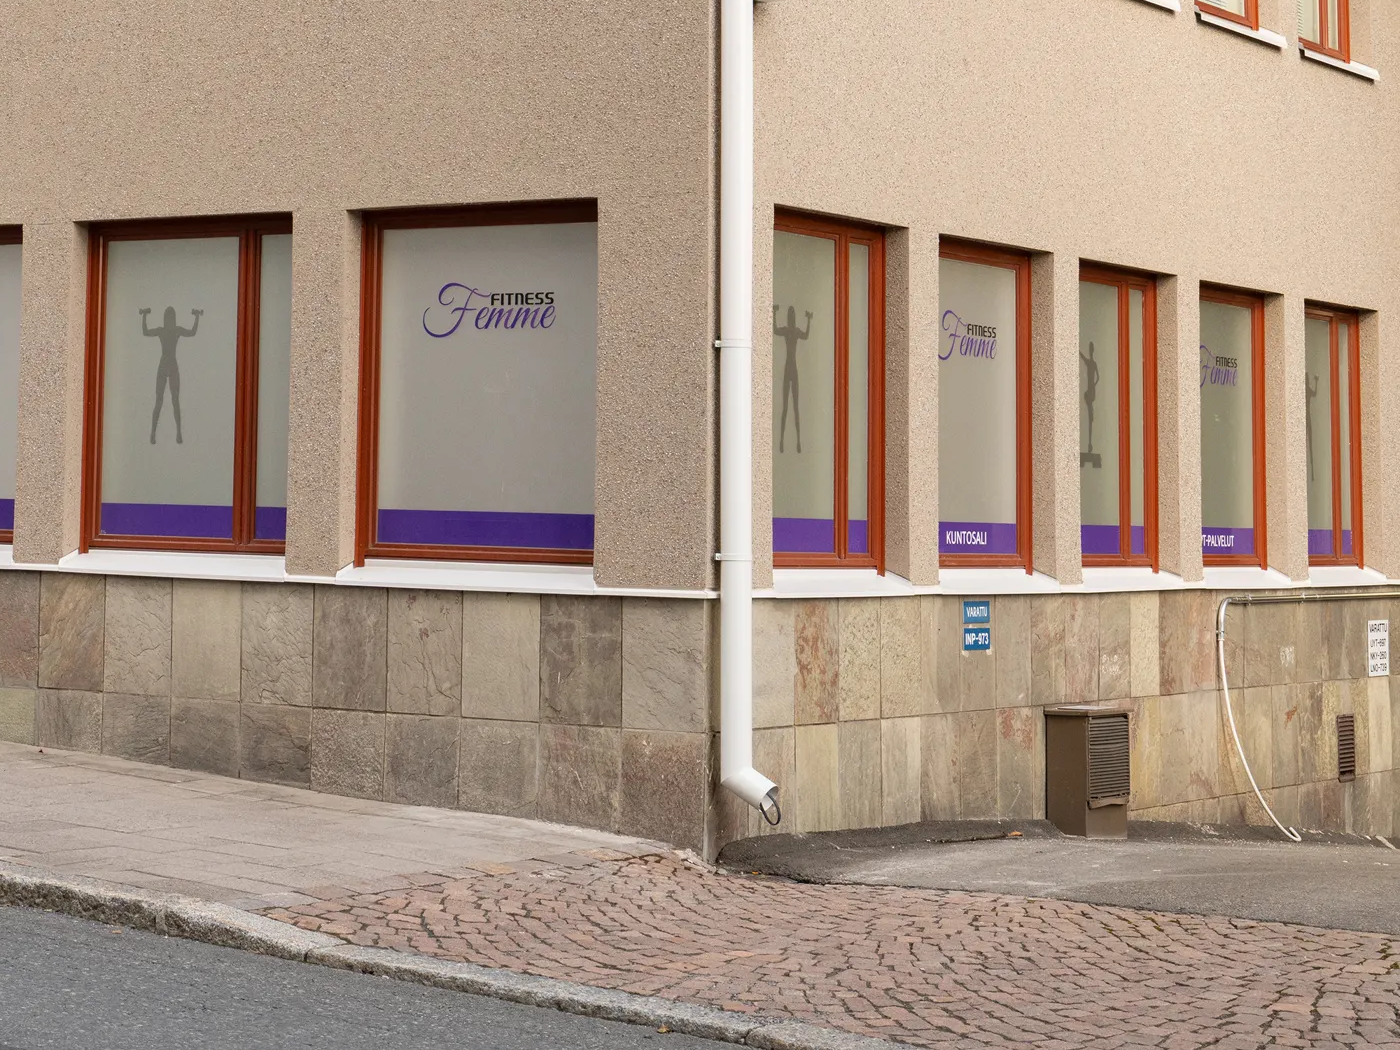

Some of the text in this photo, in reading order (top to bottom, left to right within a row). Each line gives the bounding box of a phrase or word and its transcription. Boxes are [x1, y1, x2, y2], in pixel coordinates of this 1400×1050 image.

[490, 292, 555, 306] FITNESS
[422, 282, 557, 338] Femme
[938, 309, 998, 360] Femme
[966, 323, 997, 339] FITNESS
[1215, 355, 1238, 369] FITNESS
[946, 530, 987, 545] KUNTOSALI
[1201, 534, 1235, 547] T-PALVELUT
[966, 606, 988, 618] VARATTU
[1369, 623, 1387, 632] VARATTU
